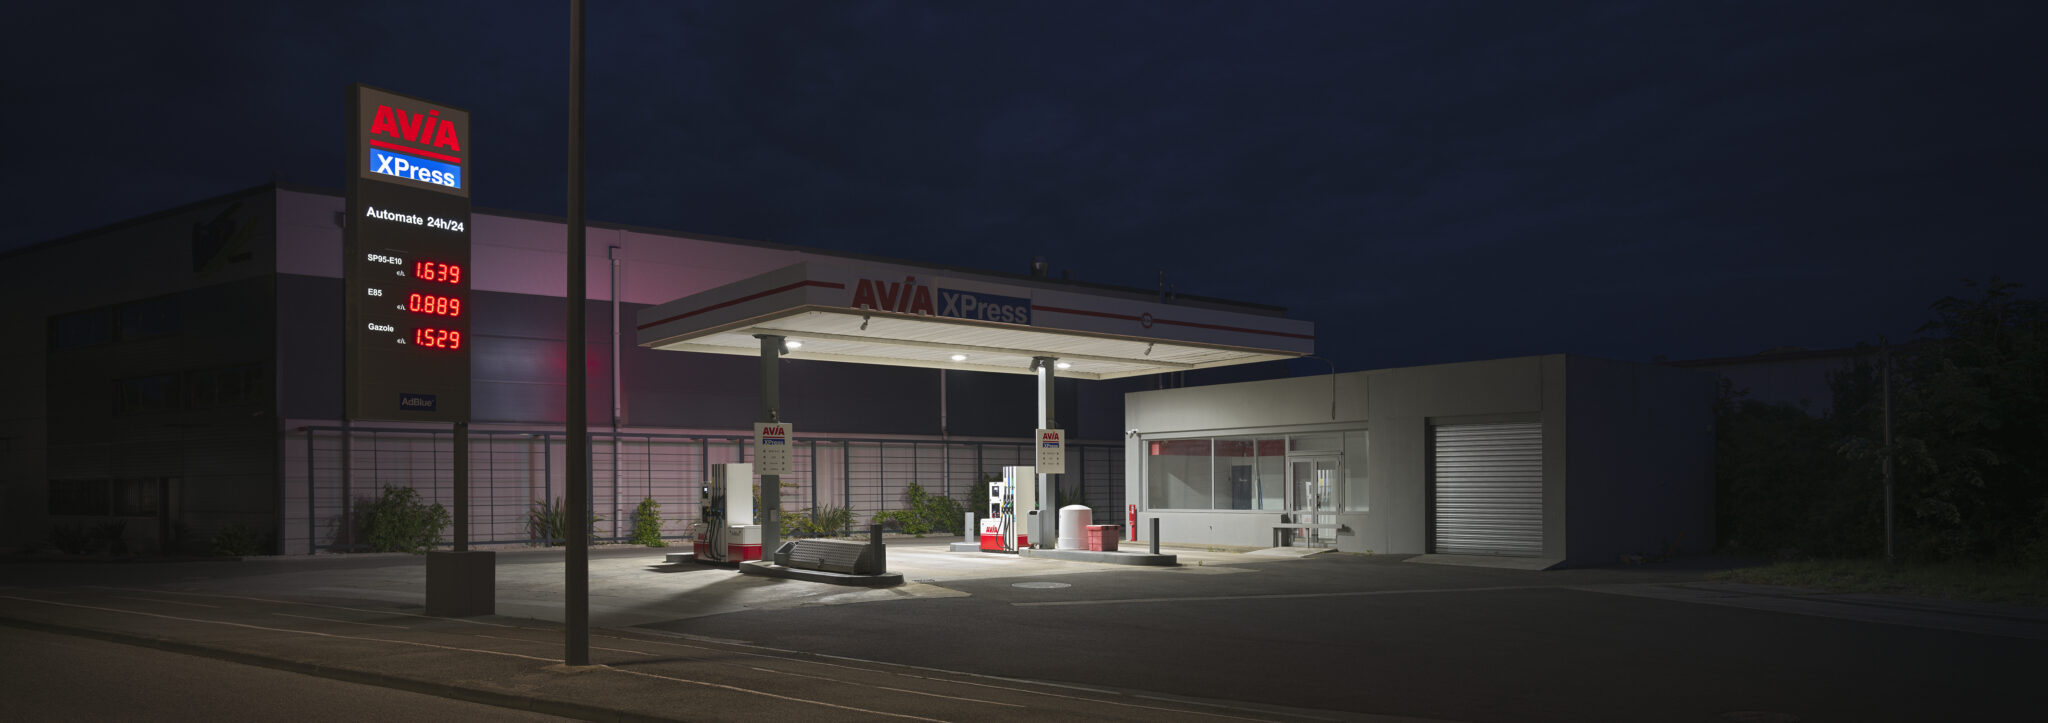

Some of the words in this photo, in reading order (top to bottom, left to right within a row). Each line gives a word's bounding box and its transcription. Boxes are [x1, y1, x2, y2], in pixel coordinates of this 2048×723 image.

[377, 153, 455, 188] XPress
[366, 206, 424, 225] Automate
[427, 216, 465, 232] 24h/24
[367, 253, 403, 265] SP95-E10
[416, 261, 460, 284] 1.639
[367, 287, 383, 297] E85
[409, 293, 460, 317] 0.889
[942, 291, 1028, 324] XPress
[367, 322, 395, 333] Gazole
[416, 327, 460, 350] 1.529
[401, 397, 433, 408] AdBlue
